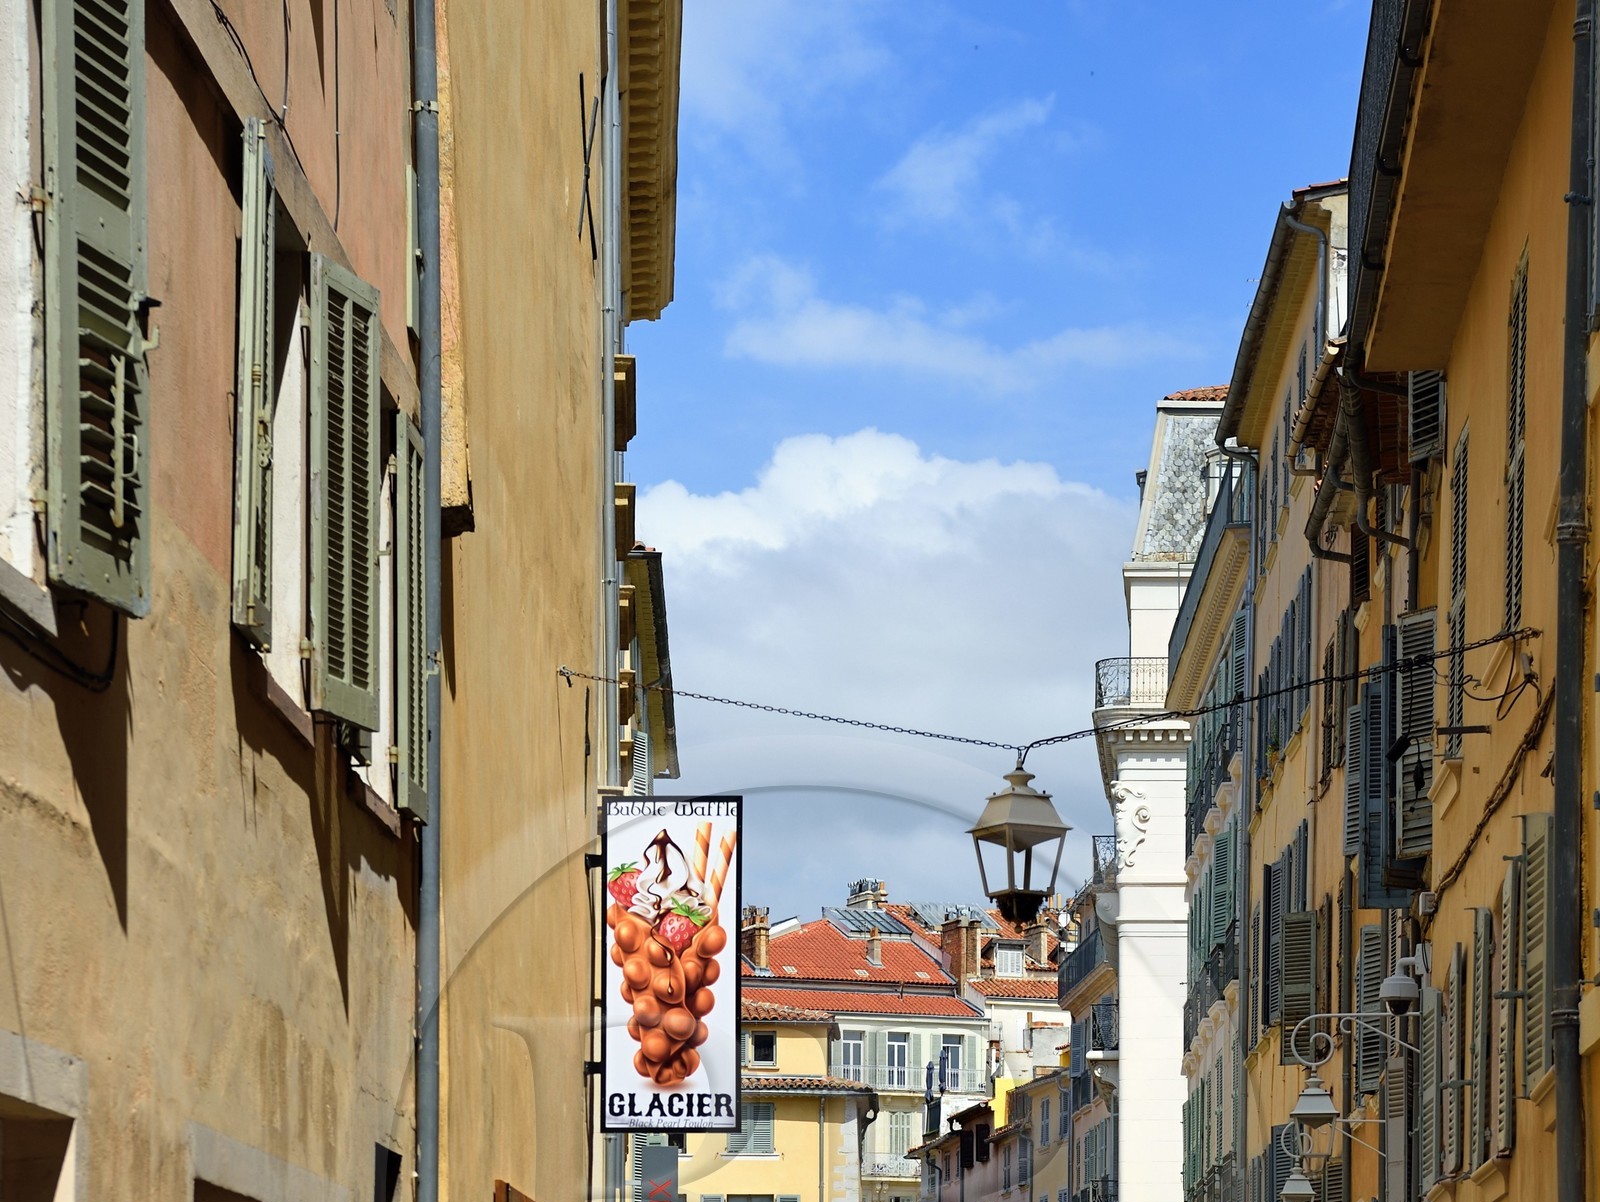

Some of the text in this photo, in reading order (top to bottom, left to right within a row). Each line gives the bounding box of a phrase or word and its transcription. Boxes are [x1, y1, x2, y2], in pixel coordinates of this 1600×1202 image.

[607, 801, 737, 817] Bubble Waffle
[608, 1092, 735, 1118] GLACIER
[627, 1118, 714, 1128] Black Pearl Toulon
